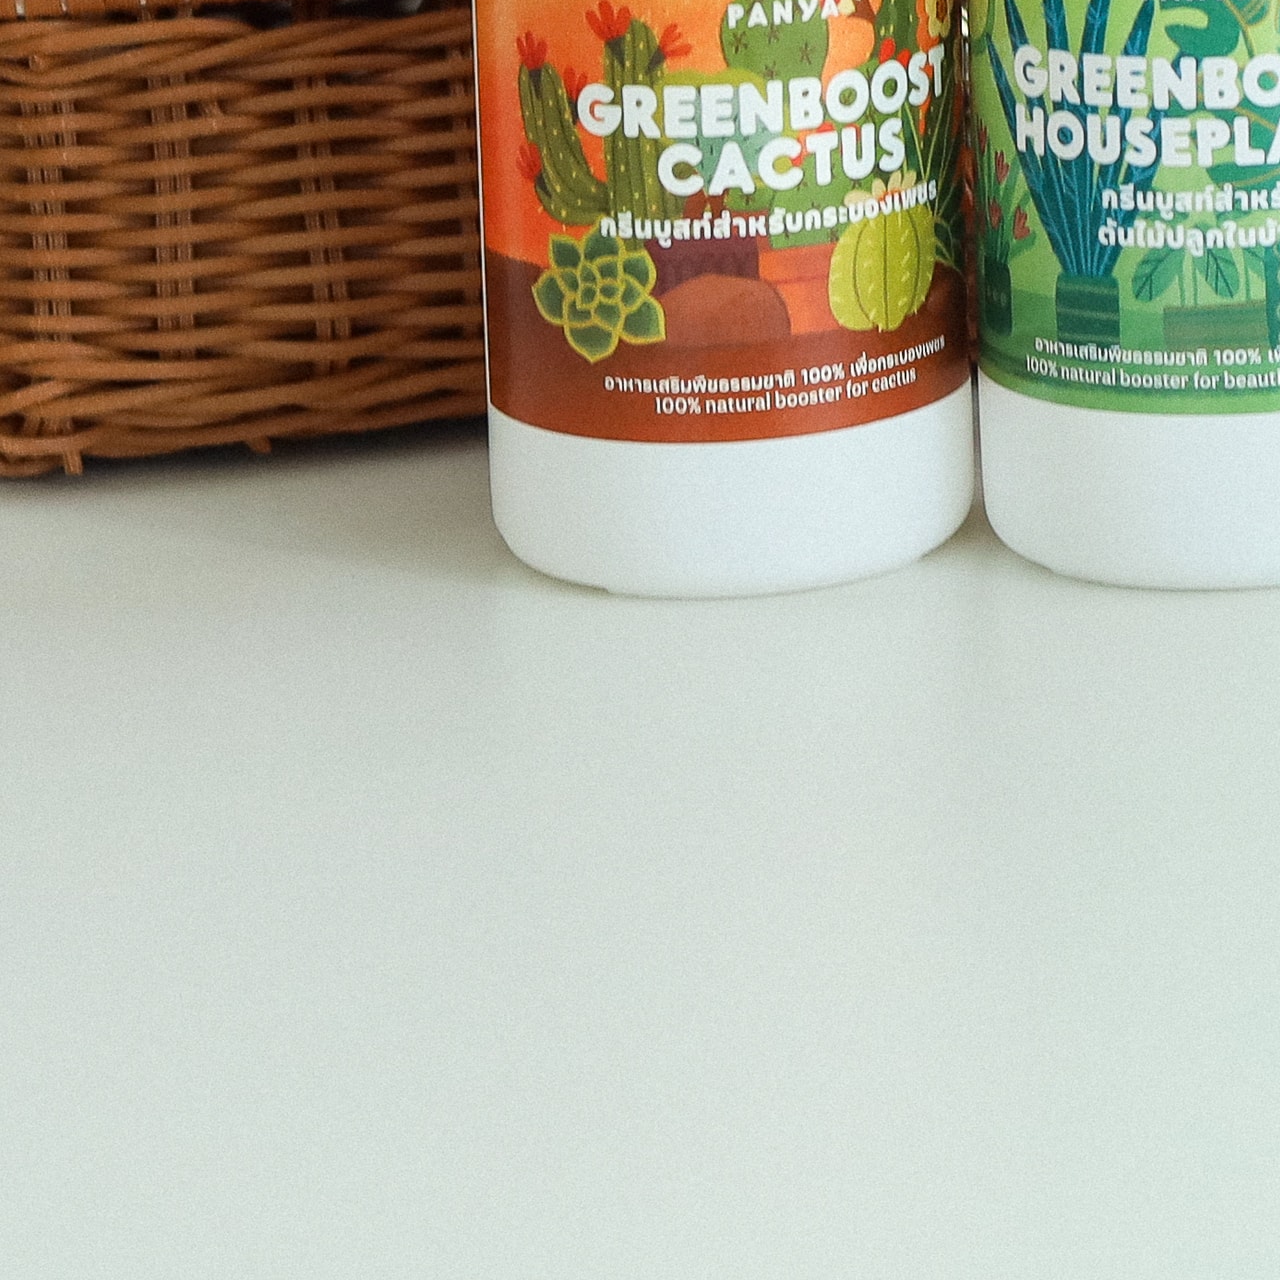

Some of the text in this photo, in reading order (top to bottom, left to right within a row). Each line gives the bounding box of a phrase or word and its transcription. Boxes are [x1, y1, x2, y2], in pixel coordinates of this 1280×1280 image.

[576, 44, 946, 140] GREENBOOST
[657, 118, 906, 197] CACTUS
[801, 362, 844, 385] 100%
[1026, 354, 1058, 378] 100%
[1060, 364, 1116, 386] natural
[1120, 368, 1189, 389] booster
[1193, 371, 1219, 389] for
[1213, 348, 1262, 366] 100%
[655, 368, 917, 415] 100% natural booster for cactus
